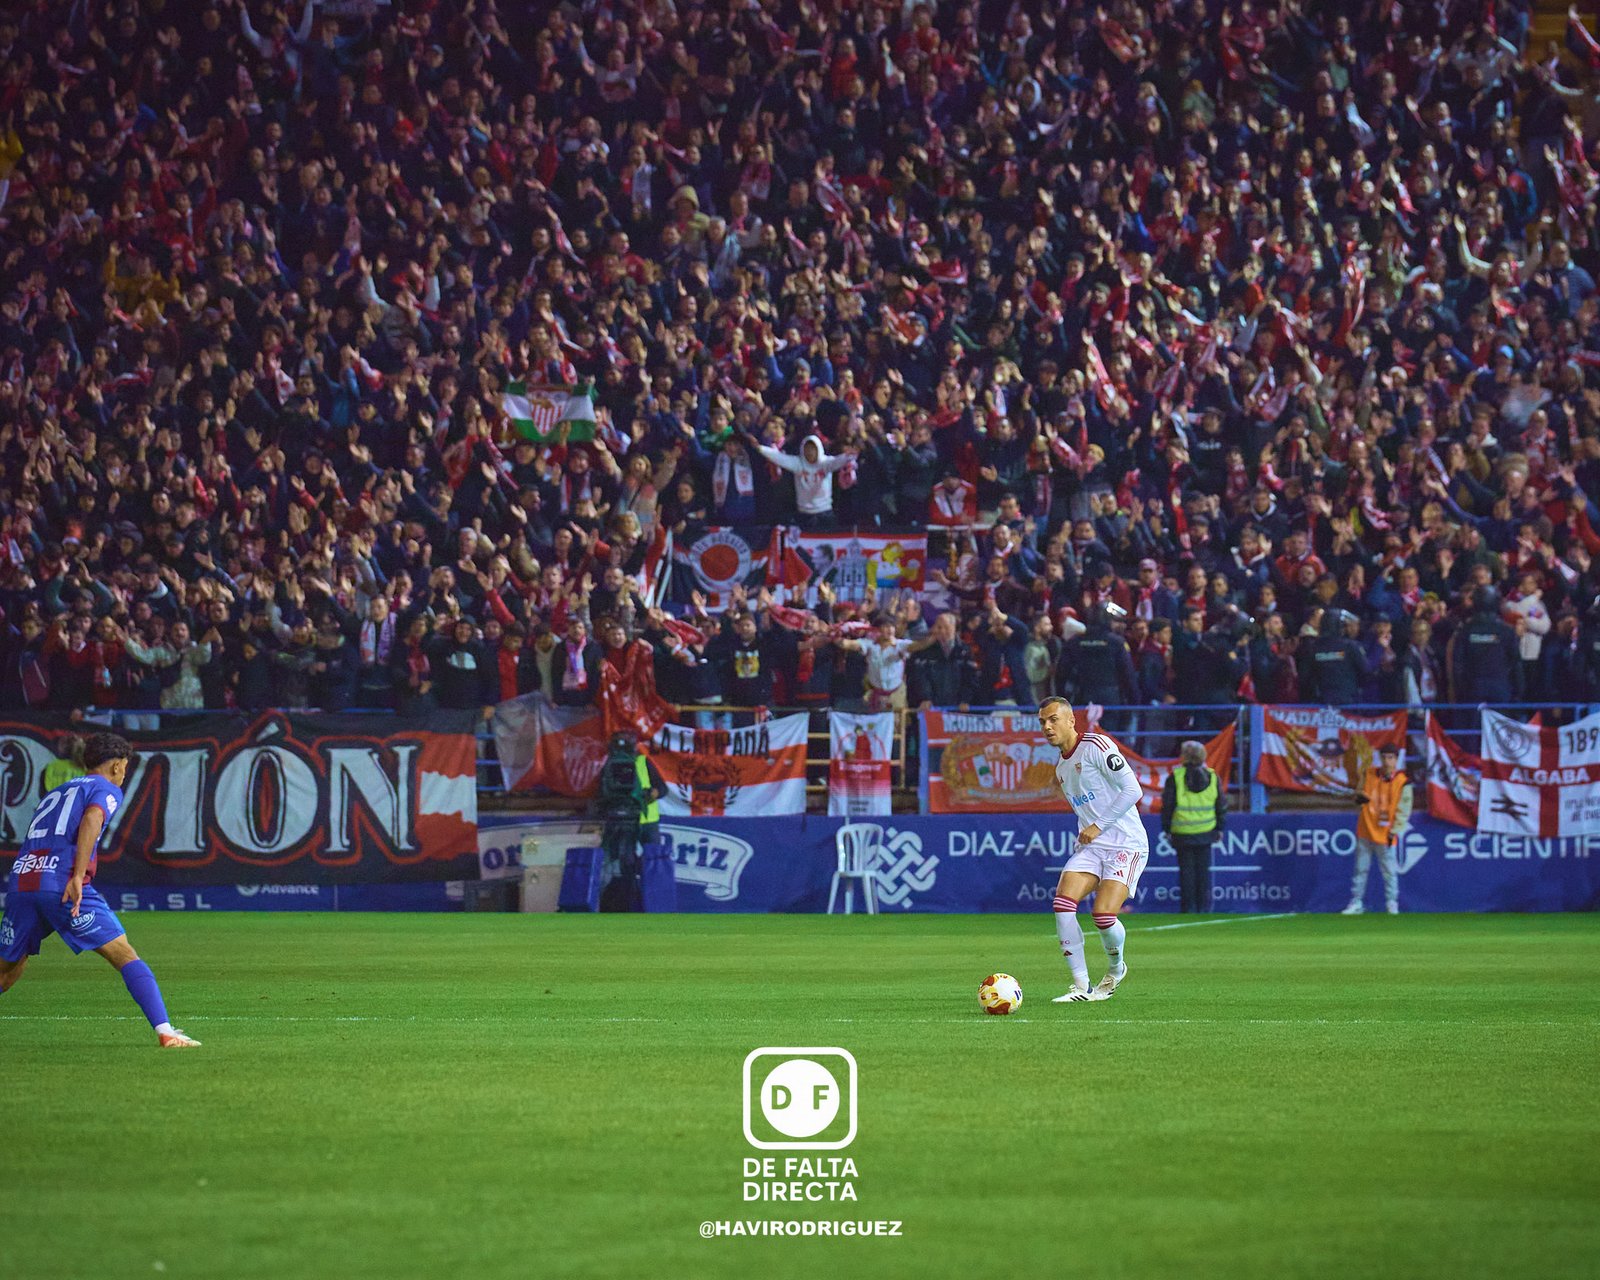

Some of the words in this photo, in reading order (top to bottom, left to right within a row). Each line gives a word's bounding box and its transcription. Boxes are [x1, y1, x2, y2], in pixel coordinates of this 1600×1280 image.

[1508, 767, 1591, 785] ALGABA
[27, 786, 80, 840] 21
[1155, 831, 1177, 856] &
